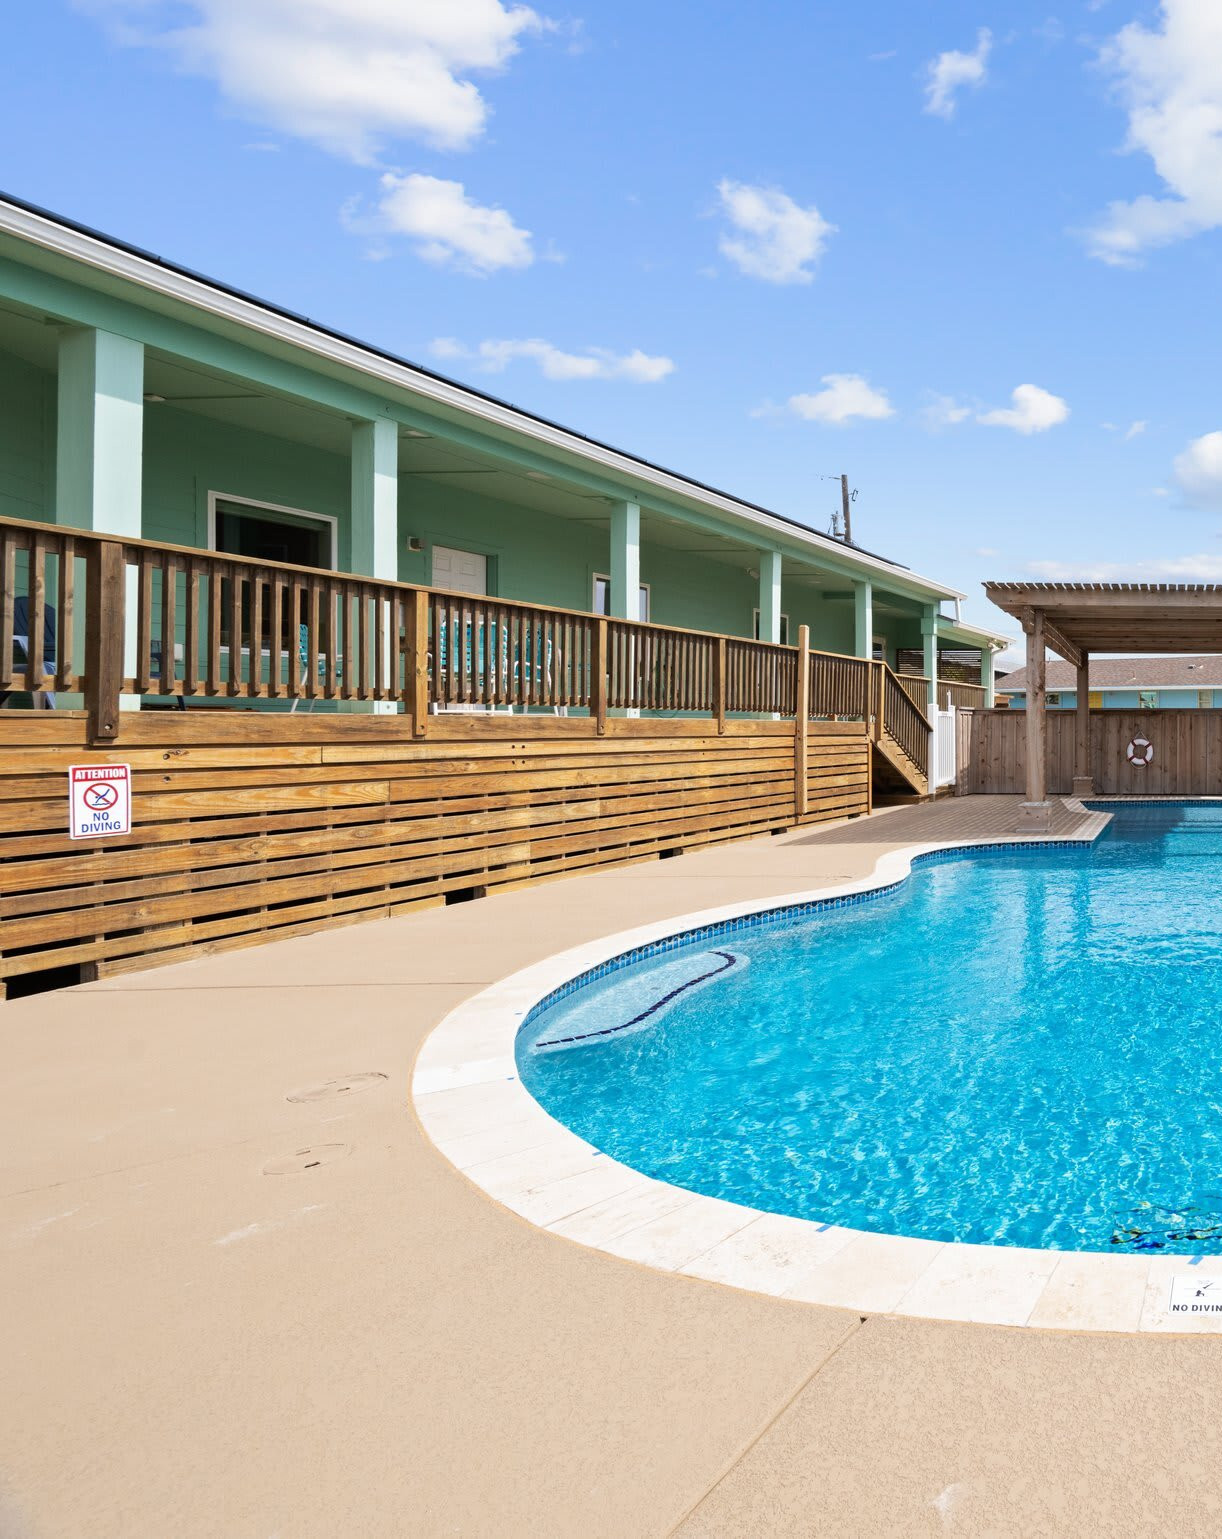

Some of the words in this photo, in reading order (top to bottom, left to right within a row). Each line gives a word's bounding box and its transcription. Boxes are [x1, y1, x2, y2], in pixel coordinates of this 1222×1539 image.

[74, 767, 126, 780] ATTENTION
[93, 811, 109, 821] NO
[81, 821, 121, 833] DIVING
[1172, 1304, 1188, 1312] NO
